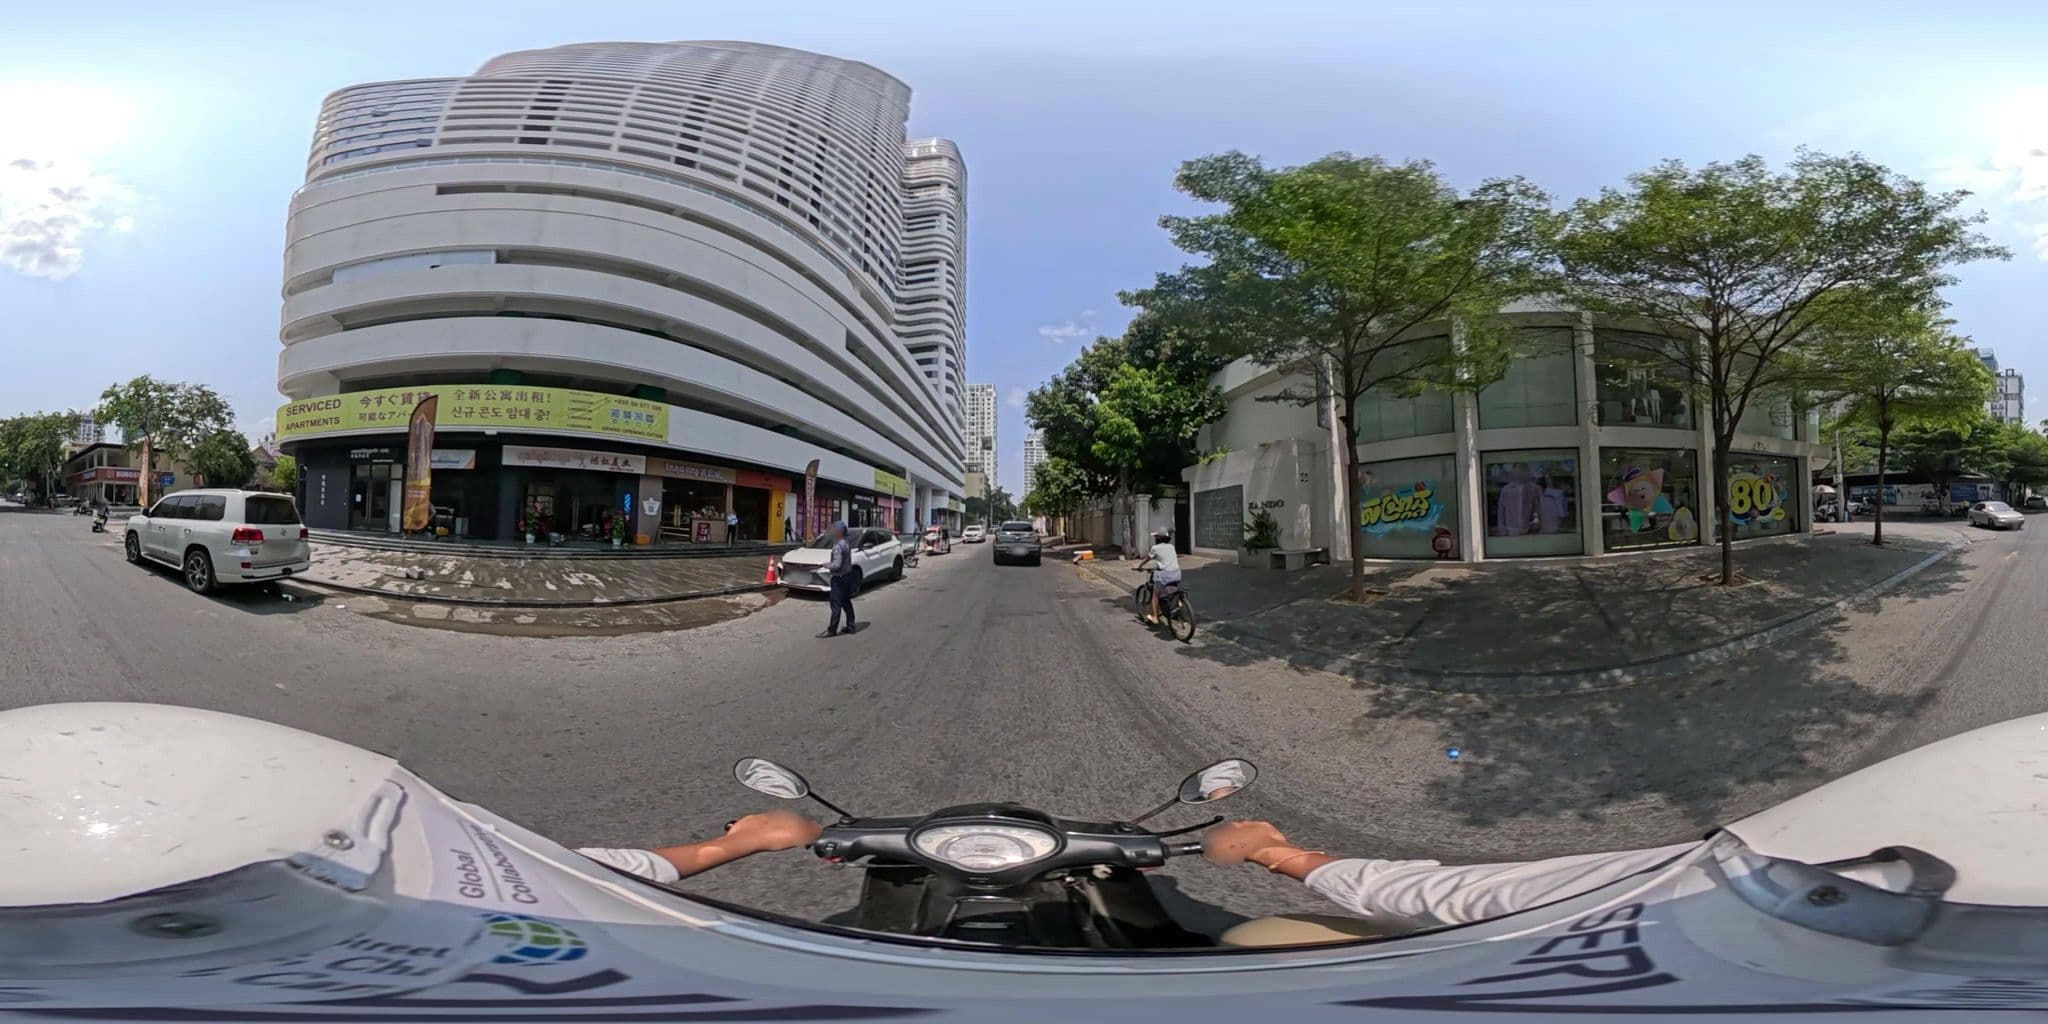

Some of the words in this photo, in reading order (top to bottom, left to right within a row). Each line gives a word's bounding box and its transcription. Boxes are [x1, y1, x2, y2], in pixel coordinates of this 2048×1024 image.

[286, 399, 341, 417] SERVICED
[285, 416, 340, 431] APARTMENTS
[1730, 478, 1774, 515] 80
[450, 849, 486, 899] Global
